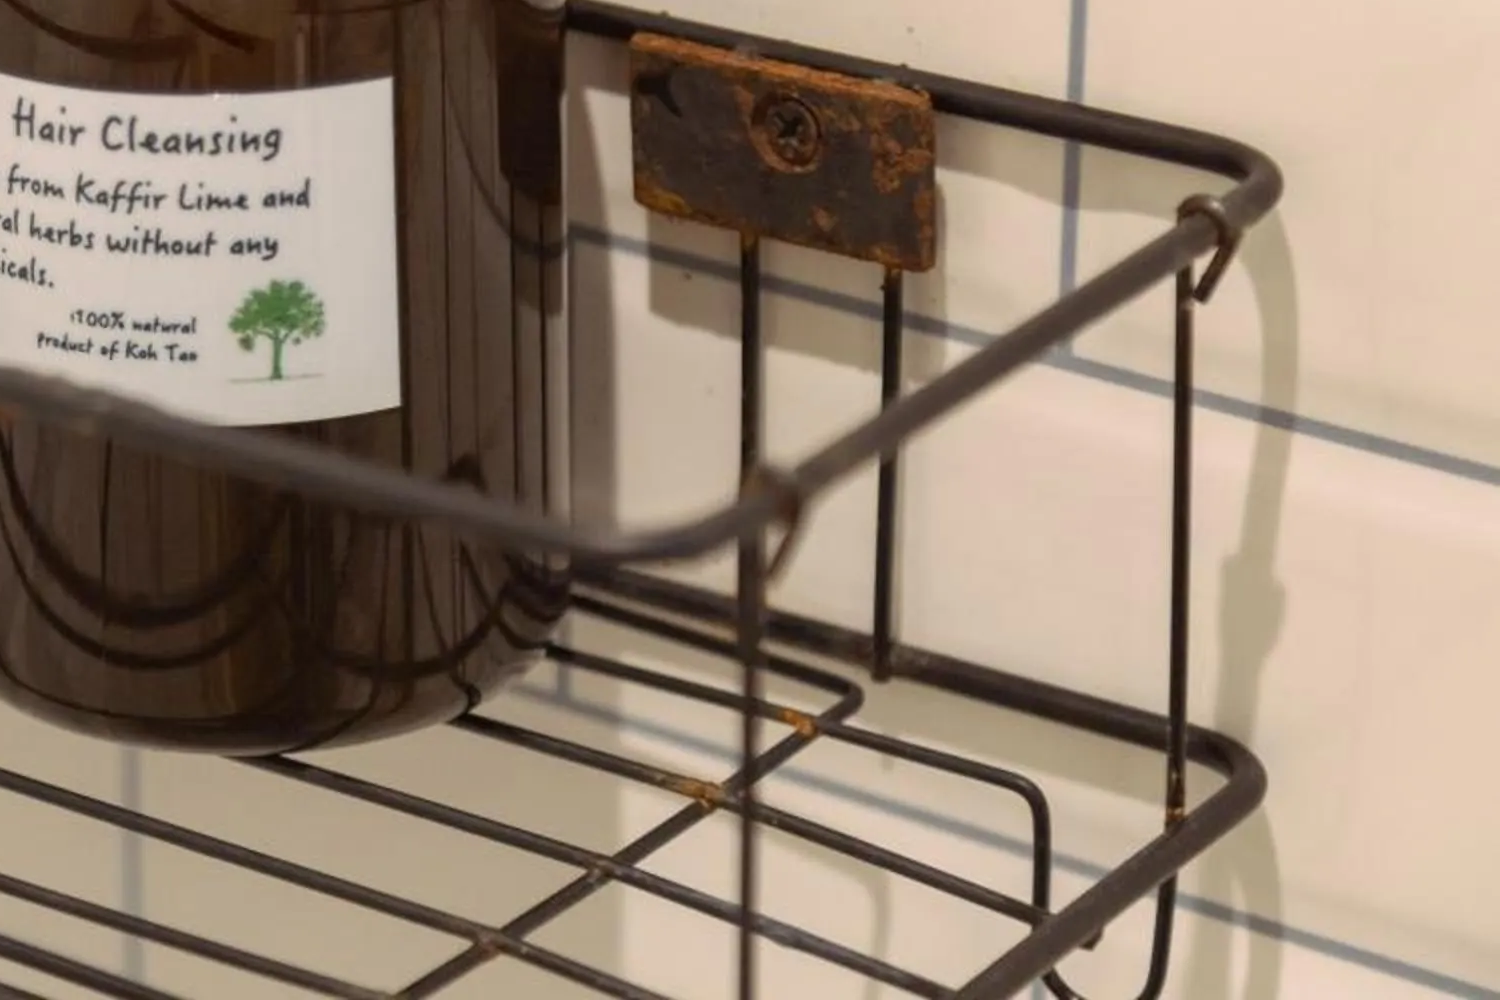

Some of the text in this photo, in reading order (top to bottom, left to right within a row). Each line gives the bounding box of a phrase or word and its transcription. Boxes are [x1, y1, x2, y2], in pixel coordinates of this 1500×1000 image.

[11, 97, 284, 161] Hair Cleansing
[7, 165, 65, 199] from
[75, 172, 167, 214] Kaffir
[178, 180, 250, 211] Lime
[261, 178, 312, 209] and
[29, 212, 95, 250] herbs
[106, 226, 216, 257] without
[229, 233, 280, 261] any
[131, 315, 197, 335] natural
[100, 340, 119, 361] of
[125, 340, 158, 361] Koh
[164, 343, 198, 362] Tao
